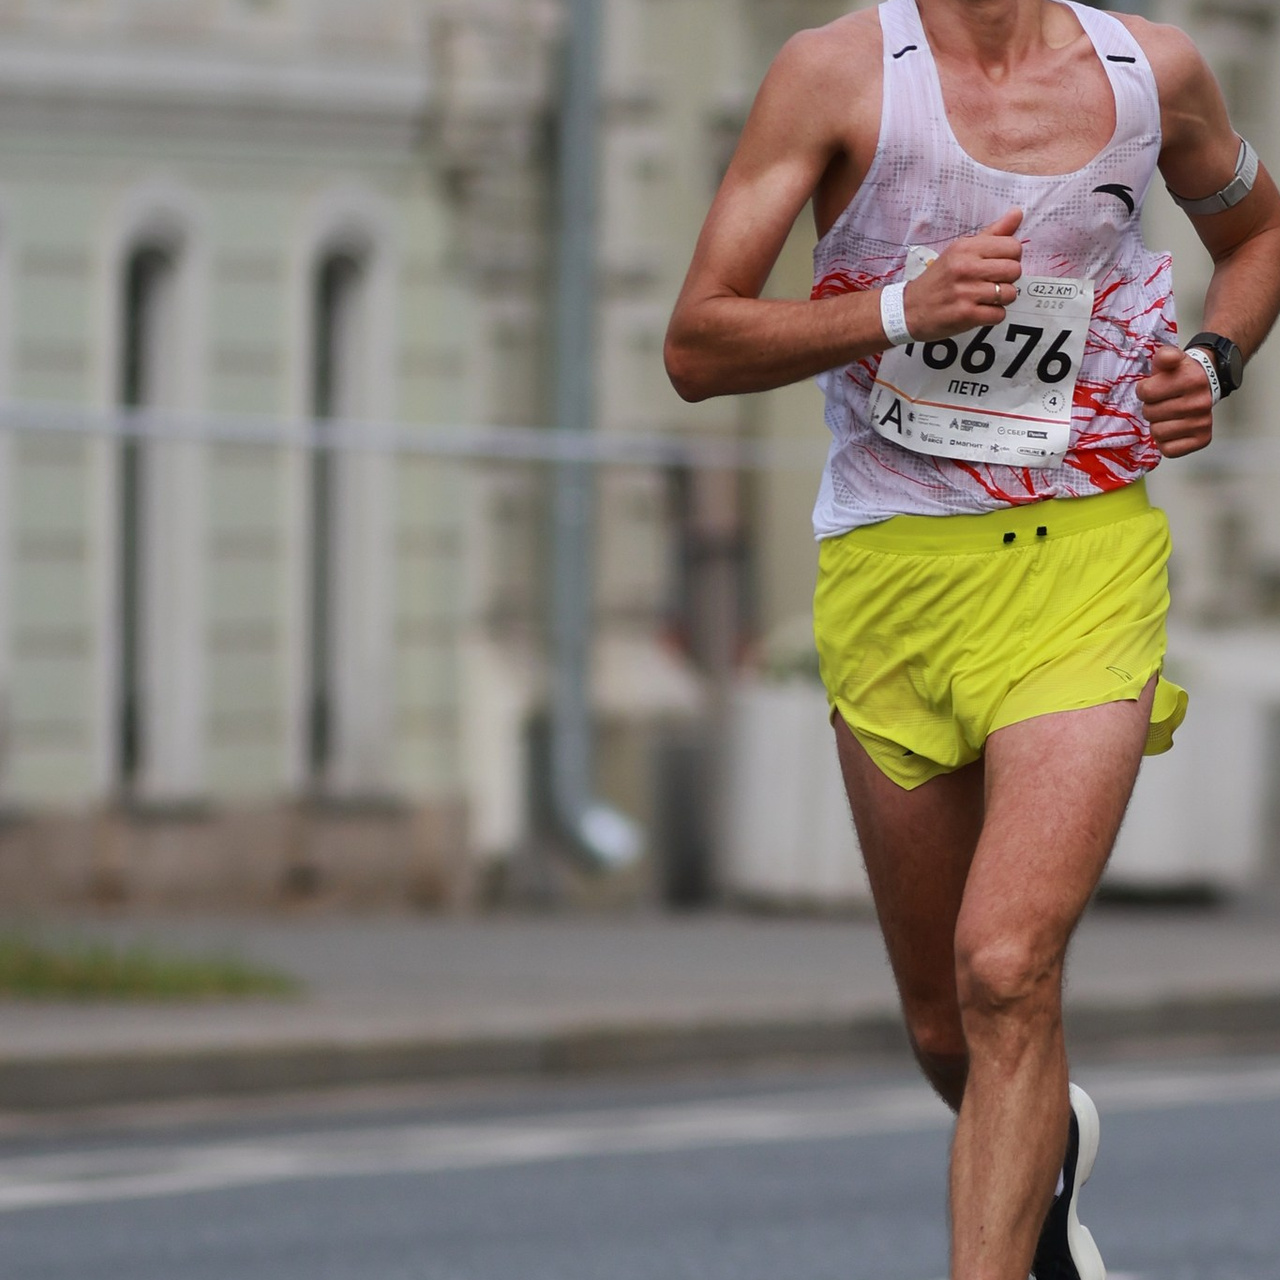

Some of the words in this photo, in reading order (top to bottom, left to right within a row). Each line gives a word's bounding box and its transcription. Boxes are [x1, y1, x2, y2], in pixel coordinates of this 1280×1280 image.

[904, 323, 1073, 384] 6676
[947, 379, 990, 397] ПЕТР
[1048, 396, 1058, 406] 4
[1006, 428, 1026, 437] СБЕР
